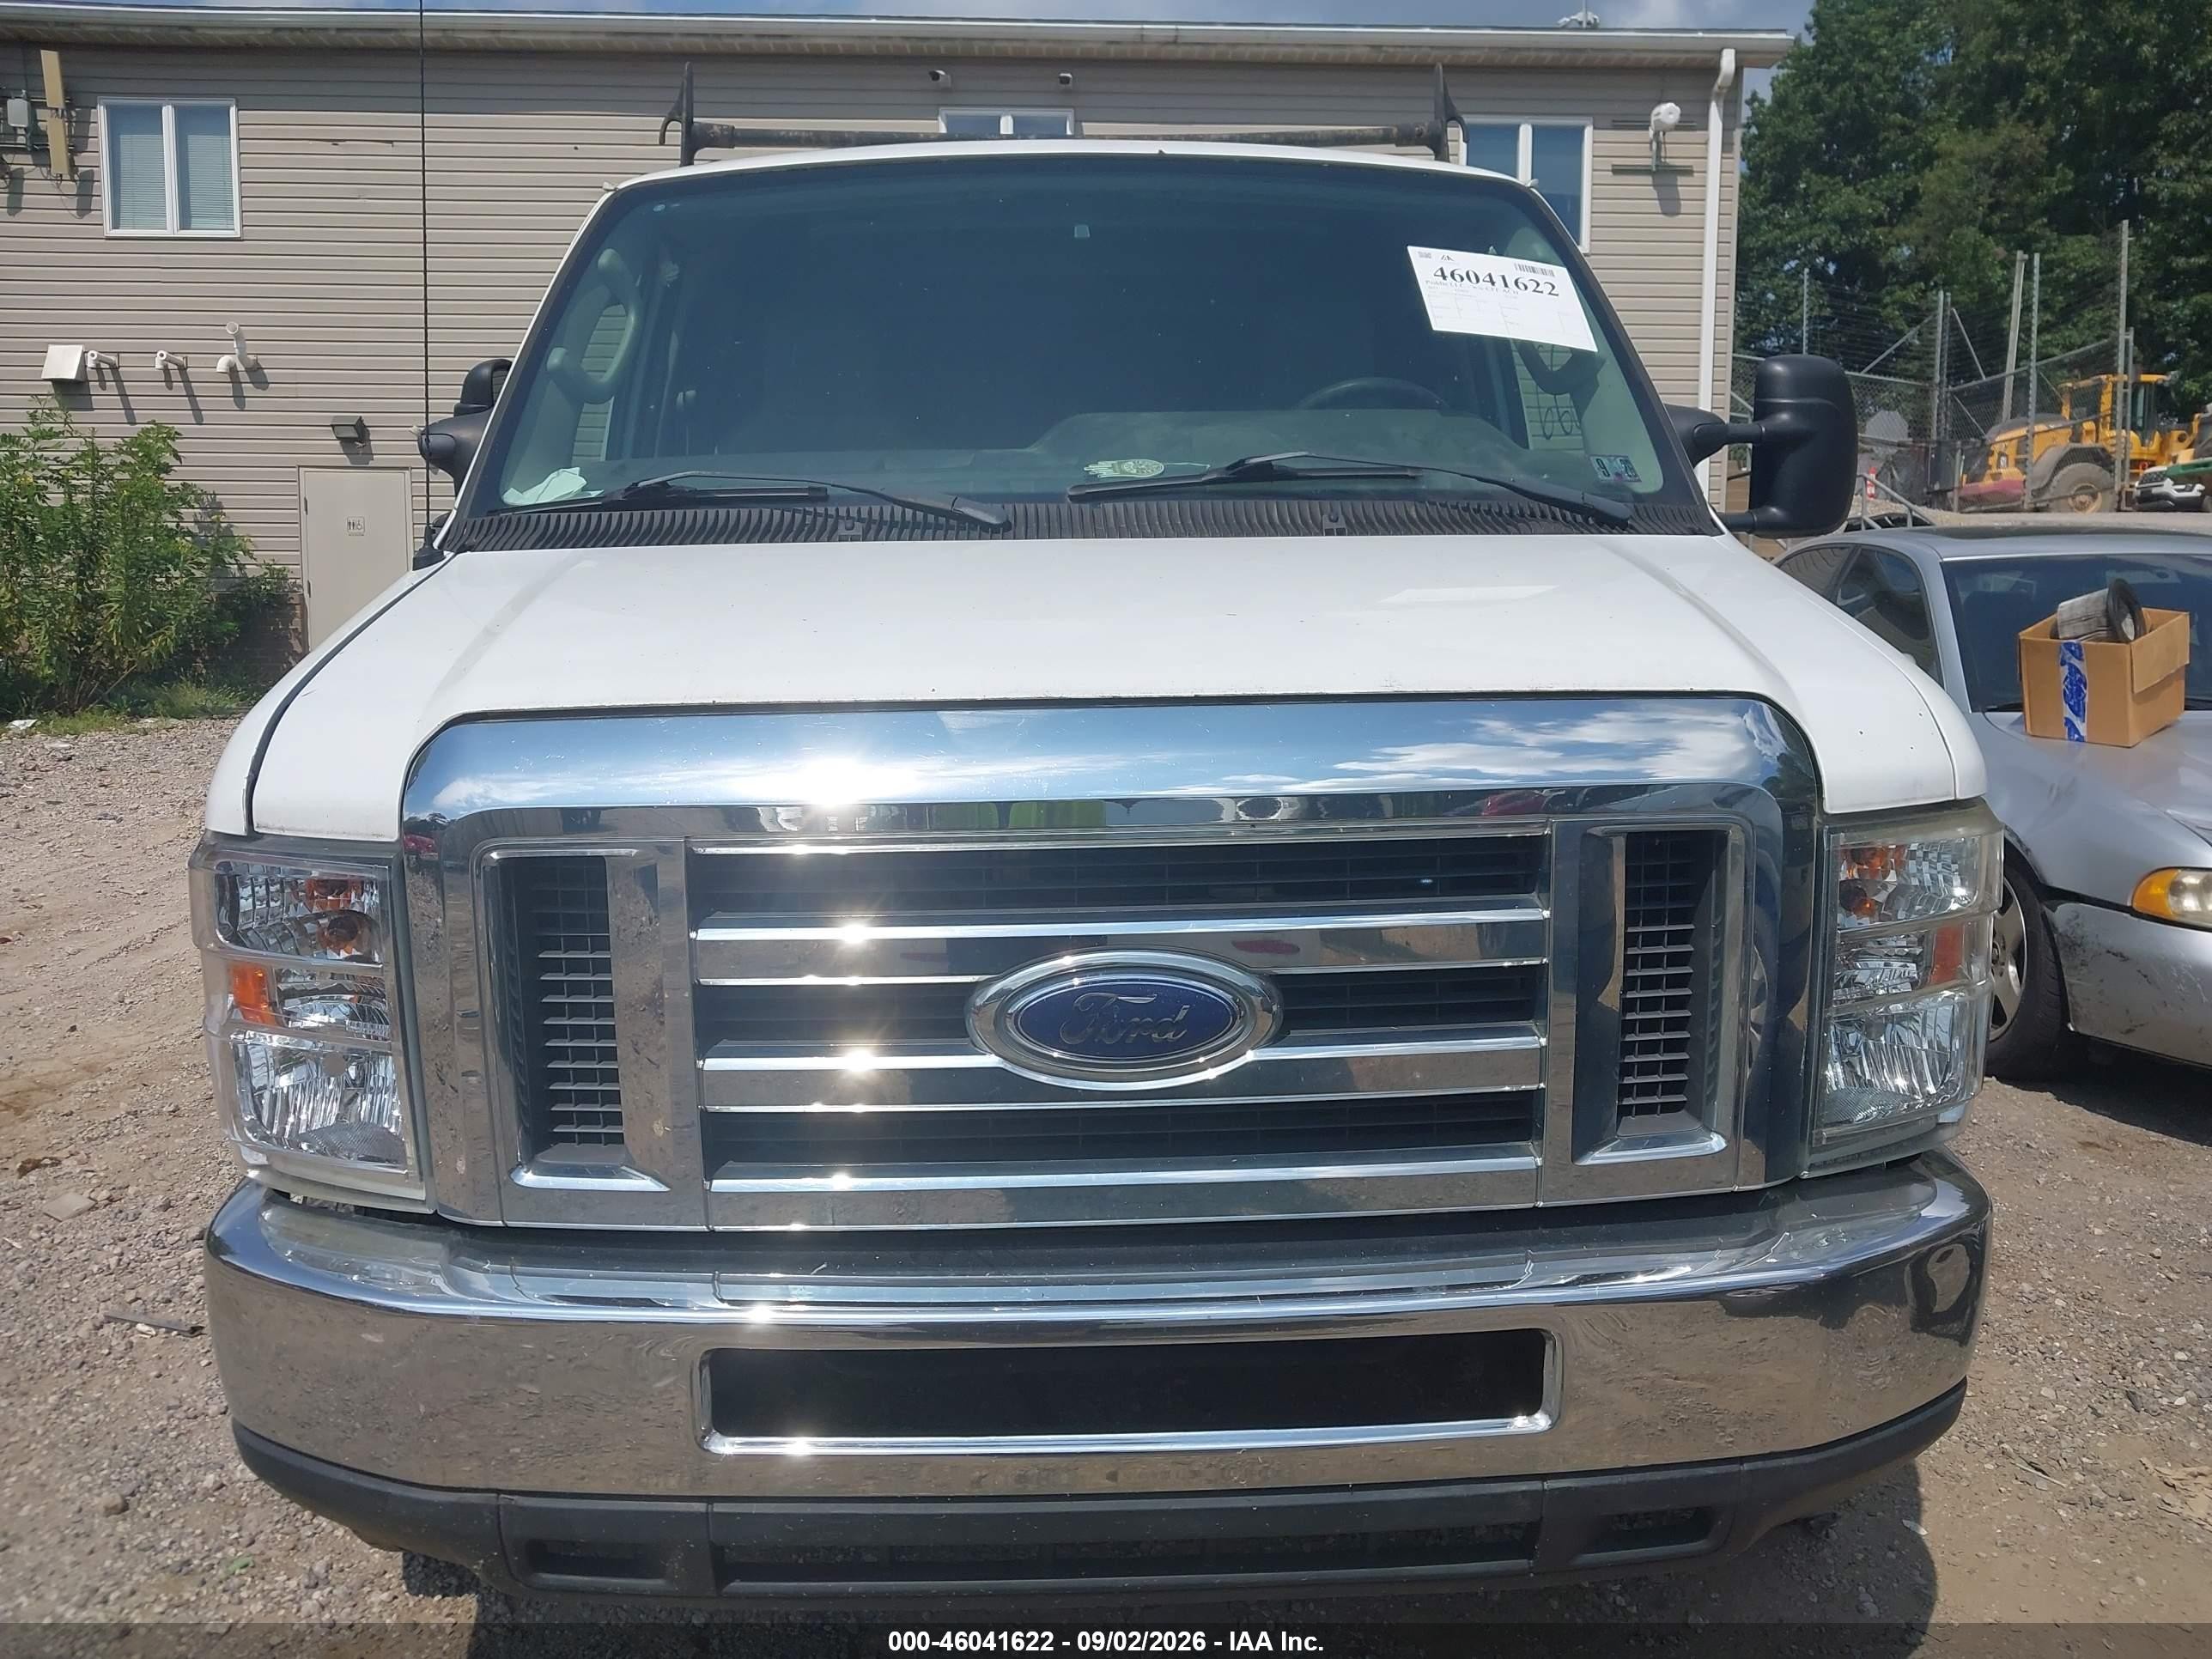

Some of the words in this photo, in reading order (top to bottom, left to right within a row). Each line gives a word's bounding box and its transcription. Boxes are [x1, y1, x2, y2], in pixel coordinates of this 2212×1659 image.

[1433, 265, 1559, 297] 46041622
[1595, 458, 1610, 477] 9
[1059, 992, 1190, 1045] Ford
